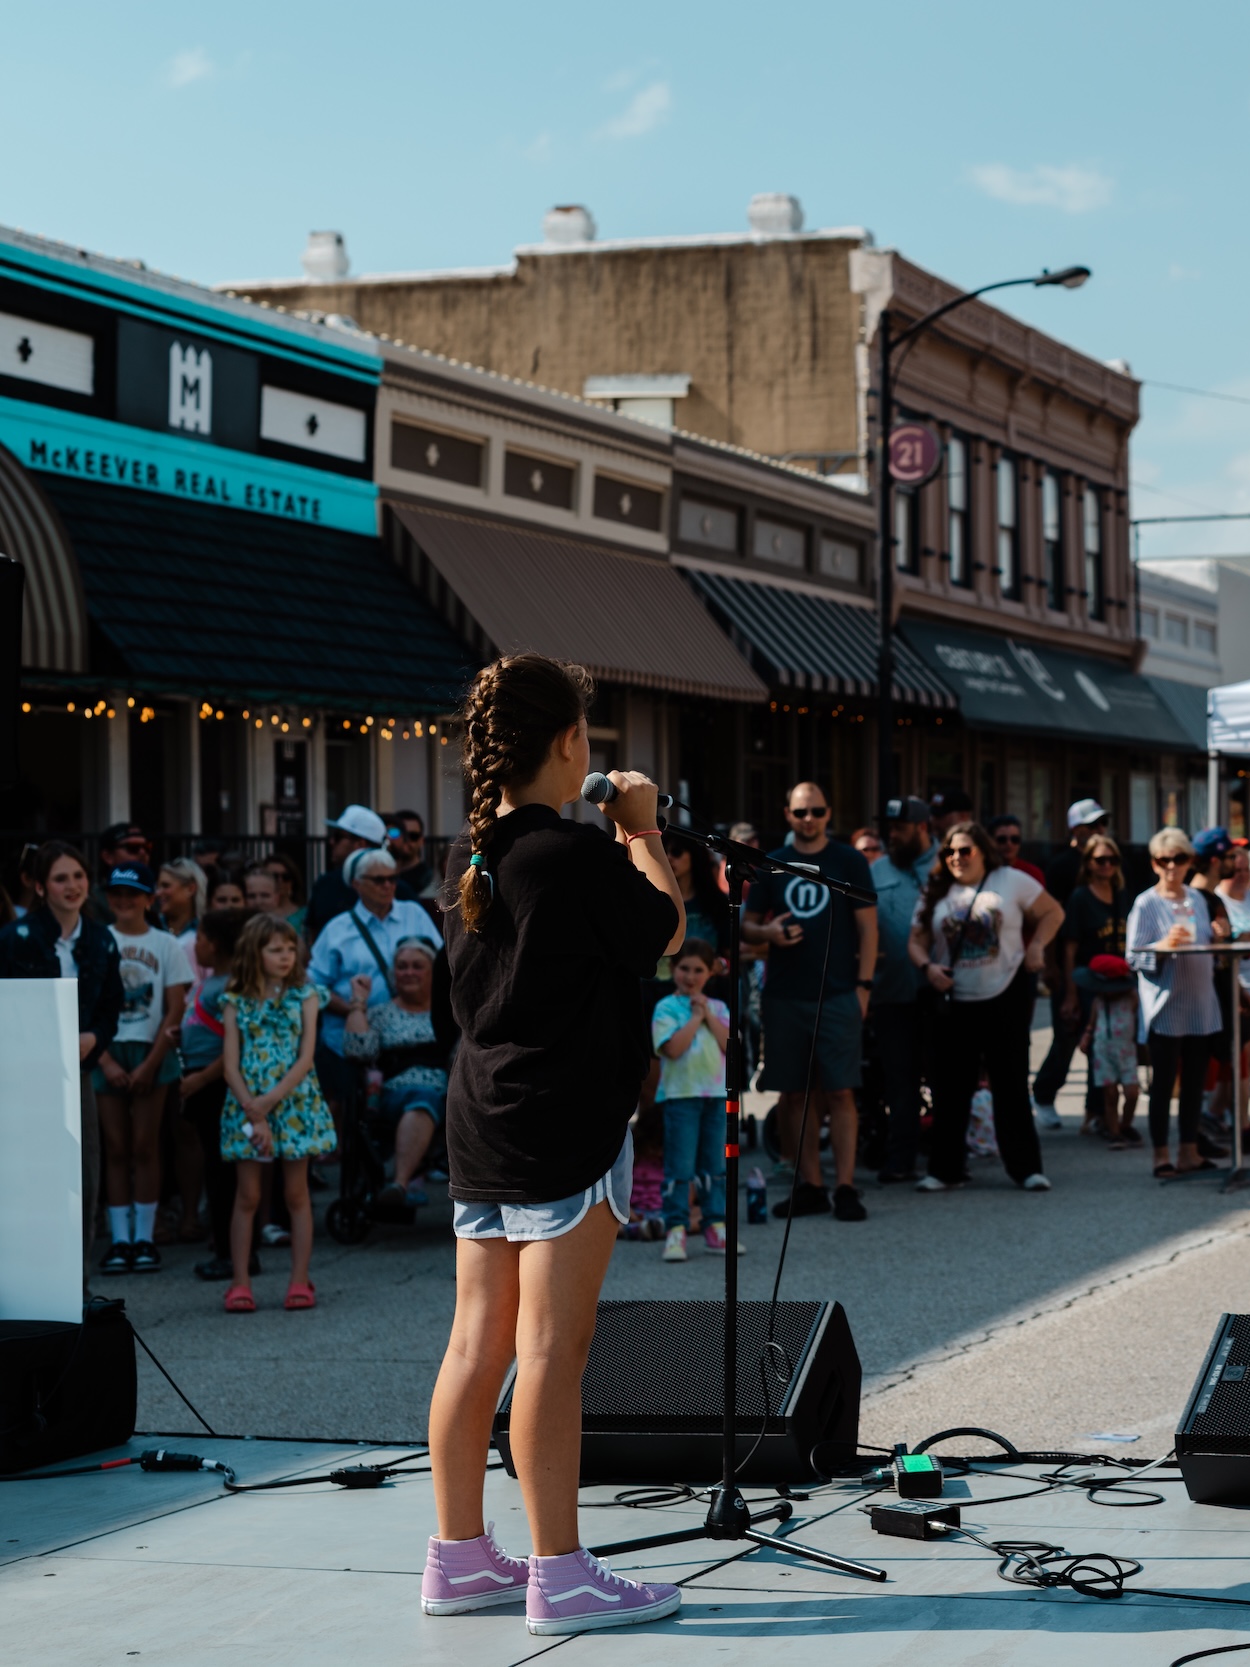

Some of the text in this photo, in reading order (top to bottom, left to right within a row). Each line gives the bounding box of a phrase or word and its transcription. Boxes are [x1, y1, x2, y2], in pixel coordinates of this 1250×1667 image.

[30, 438, 322, 521] McKEEVER REAL ESTATE
